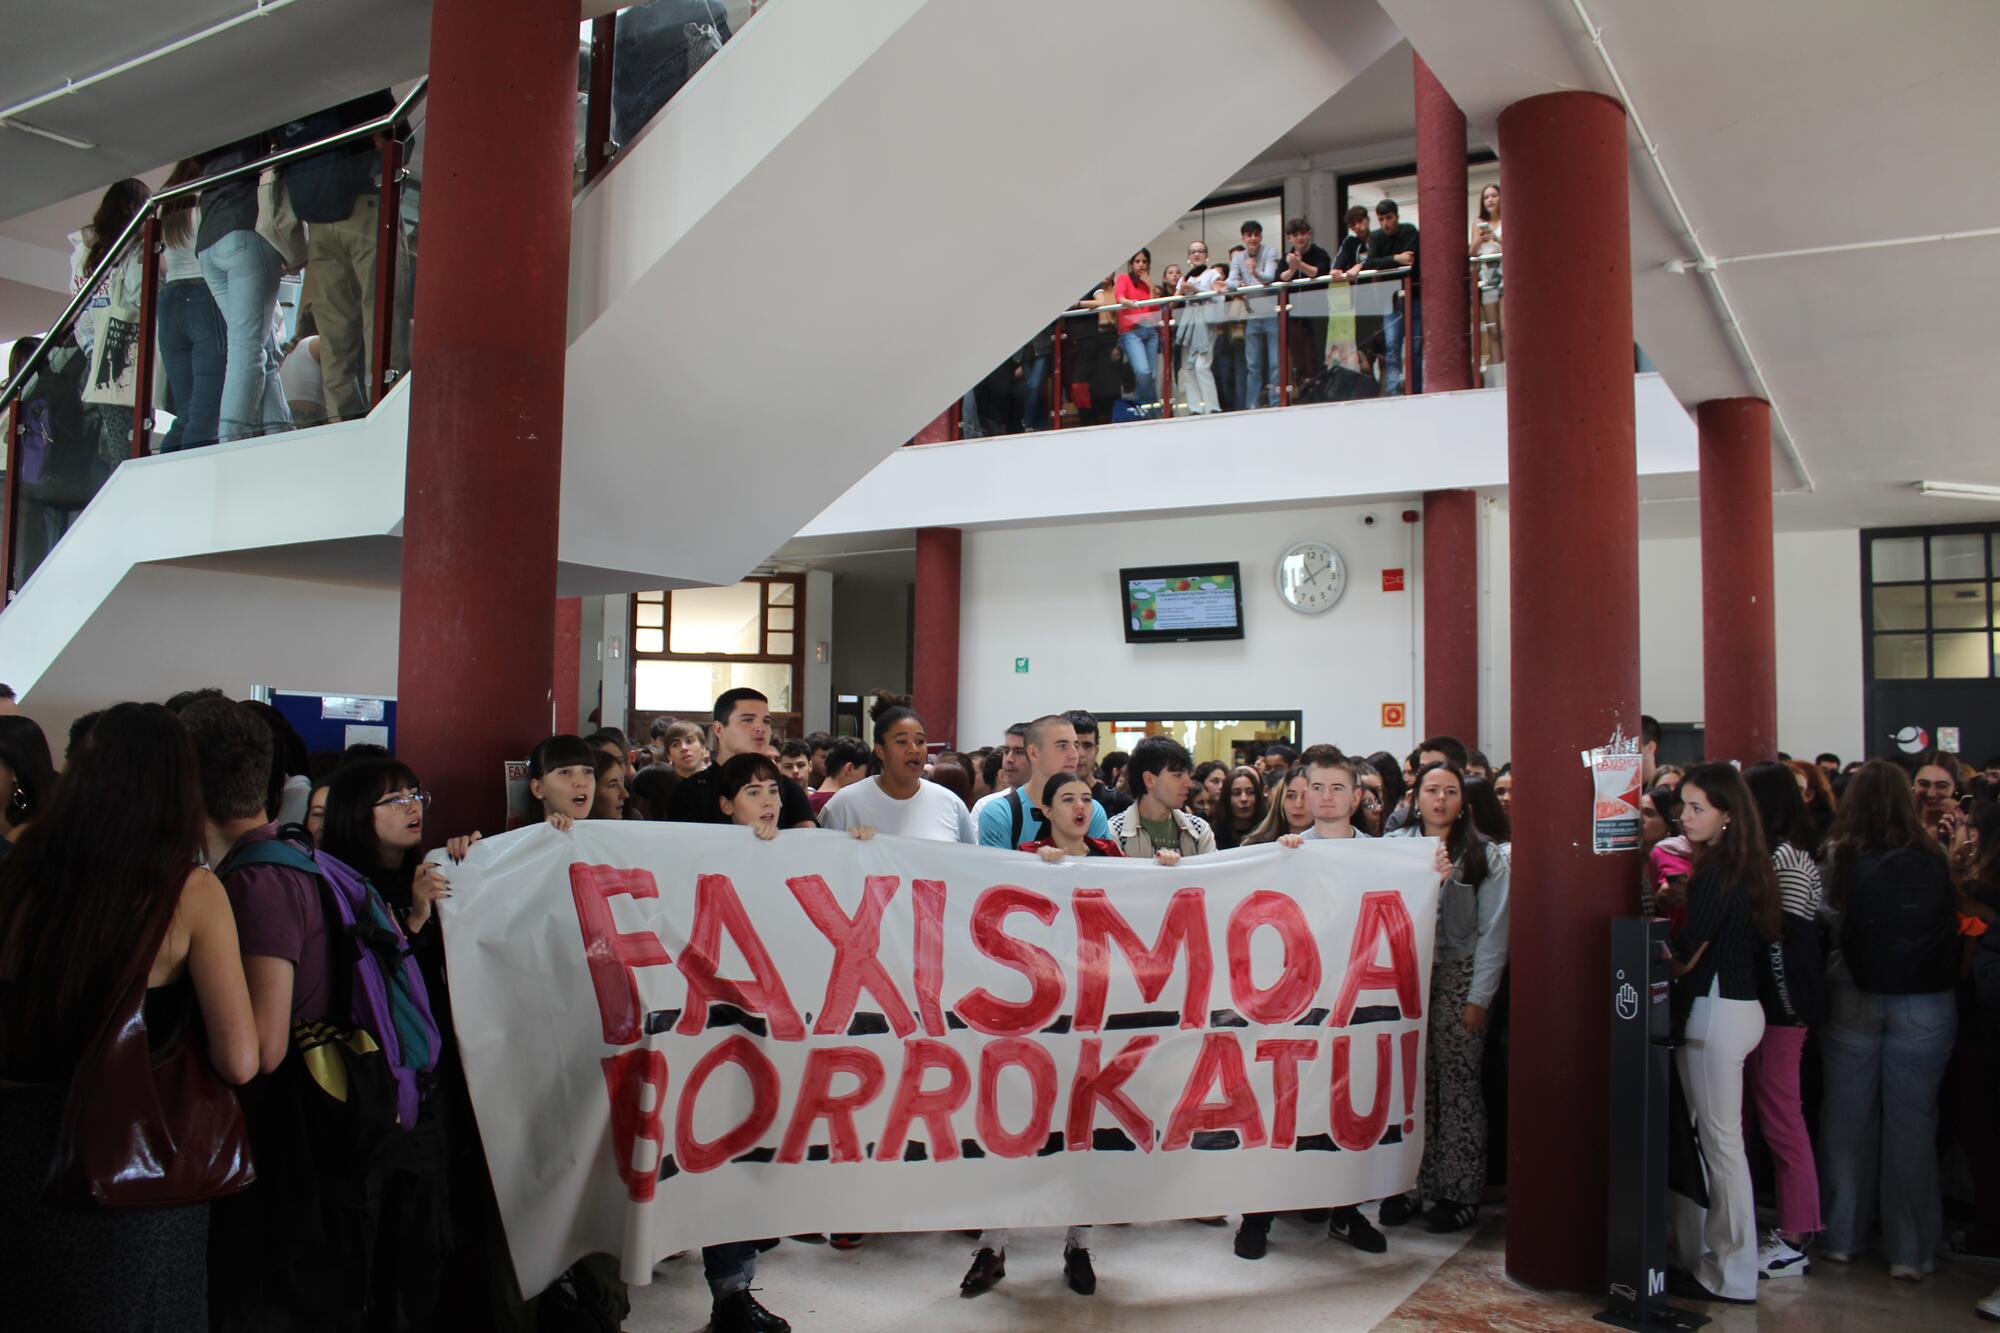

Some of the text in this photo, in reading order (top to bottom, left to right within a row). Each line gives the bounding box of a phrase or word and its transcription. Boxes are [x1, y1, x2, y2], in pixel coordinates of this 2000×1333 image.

[1306, 551, 1316, 560] 12
[569, 862, 1422, 1045] FAXISMOA
[600, 1030, 1419, 1203] BORROKATU!
[1648, 1268, 1664, 1297] M
